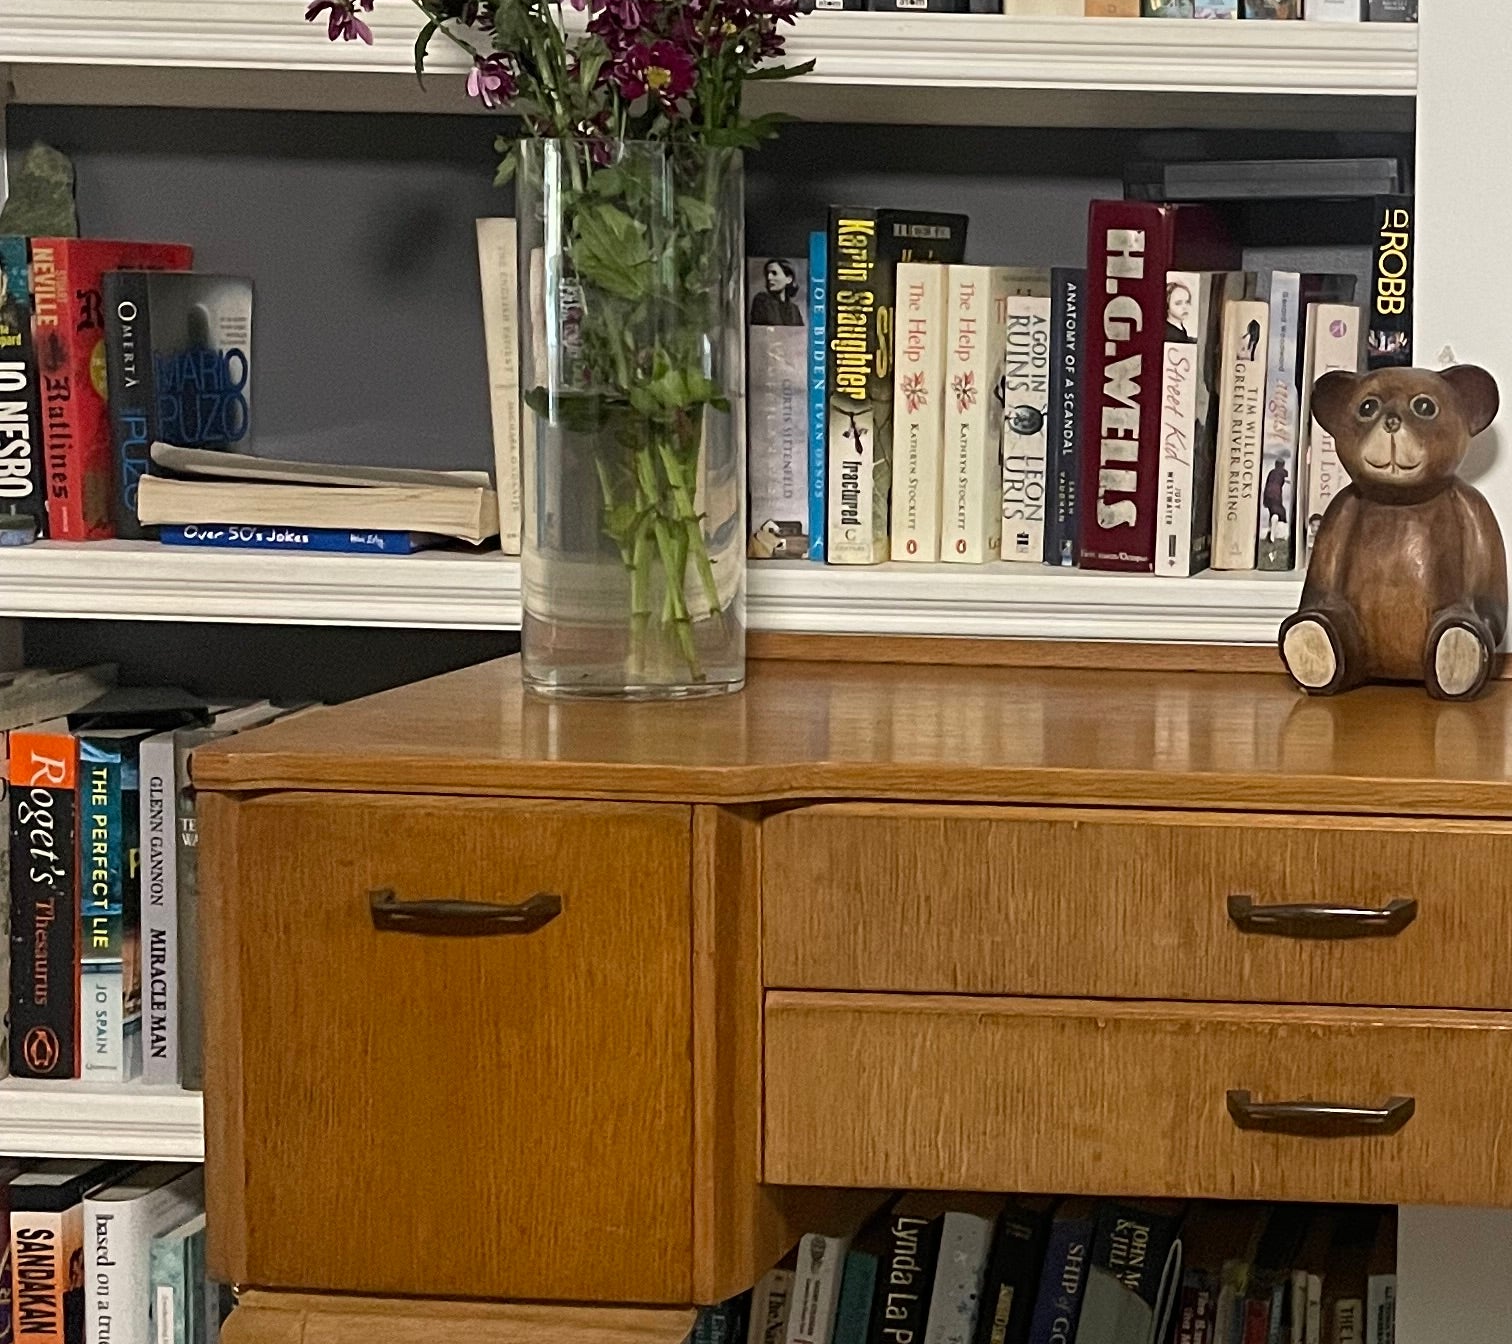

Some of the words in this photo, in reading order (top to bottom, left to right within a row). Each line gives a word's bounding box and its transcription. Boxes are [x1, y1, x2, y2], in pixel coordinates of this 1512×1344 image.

[837, 219, 875, 282] Karin
[1377, 232, 1408, 315] ROBB
[33, 247, 57, 327] NEVILLE
[906, 282, 919, 320] The
[903, 319, 927, 362] Help
[1065, 282, 1077, 352] ANATOMY
[831, 291, 874, 400] Slaughter
[1006, 314, 1031, 392] RUINS
[1065, 379, 1074, 388] A
[1168, 347, 1191, 417] Street
[1232, 363, 1245, 417] GREEN
[1247, 387, 1259, 415] TIM
[1063, 393, 1075, 455] SCANDAL
[1164, 423, 1190, 467] Kid
[1230, 419, 1244, 467] RIVER
[1003, 455, 1024, 519] URIS
[1242, 418, 1259, 500] WILLOCKS
[1021, 455, 1044, 522] LEON
[1226, 470, 1242, 522] RISING
[184, 526, 223, 540] Over
[267, 528, 309, 544] Jokes
[92, 768, 107, 805] THE
[150, 776, 162, 832] GLENN
[18, 751, 66, 886] Roget's
[92, 818, 108, 909] PERFECT
[150, 837, 164, 906] GANNON
[34, 897, 54, 1005] Thesaurus
[94, 917, 108, 948] LIE
[150, 928, 166, 1007] MIRACLE
[96, 1010, 108, 1054] SPAIN
[151, 1009, 166, 1059] MAN
[96, 1214, 115, 1266] based
[890, 1217, 918, 1297] Lynda
[1061, 1242, 1085, 1293] SHIP
[16, 1229, 57, 1335] SANDAKAN
[97, 1273, 110, 1295] on
[98, 1301, 109, 1309] a
[886, 1293, 907, 1320] La
